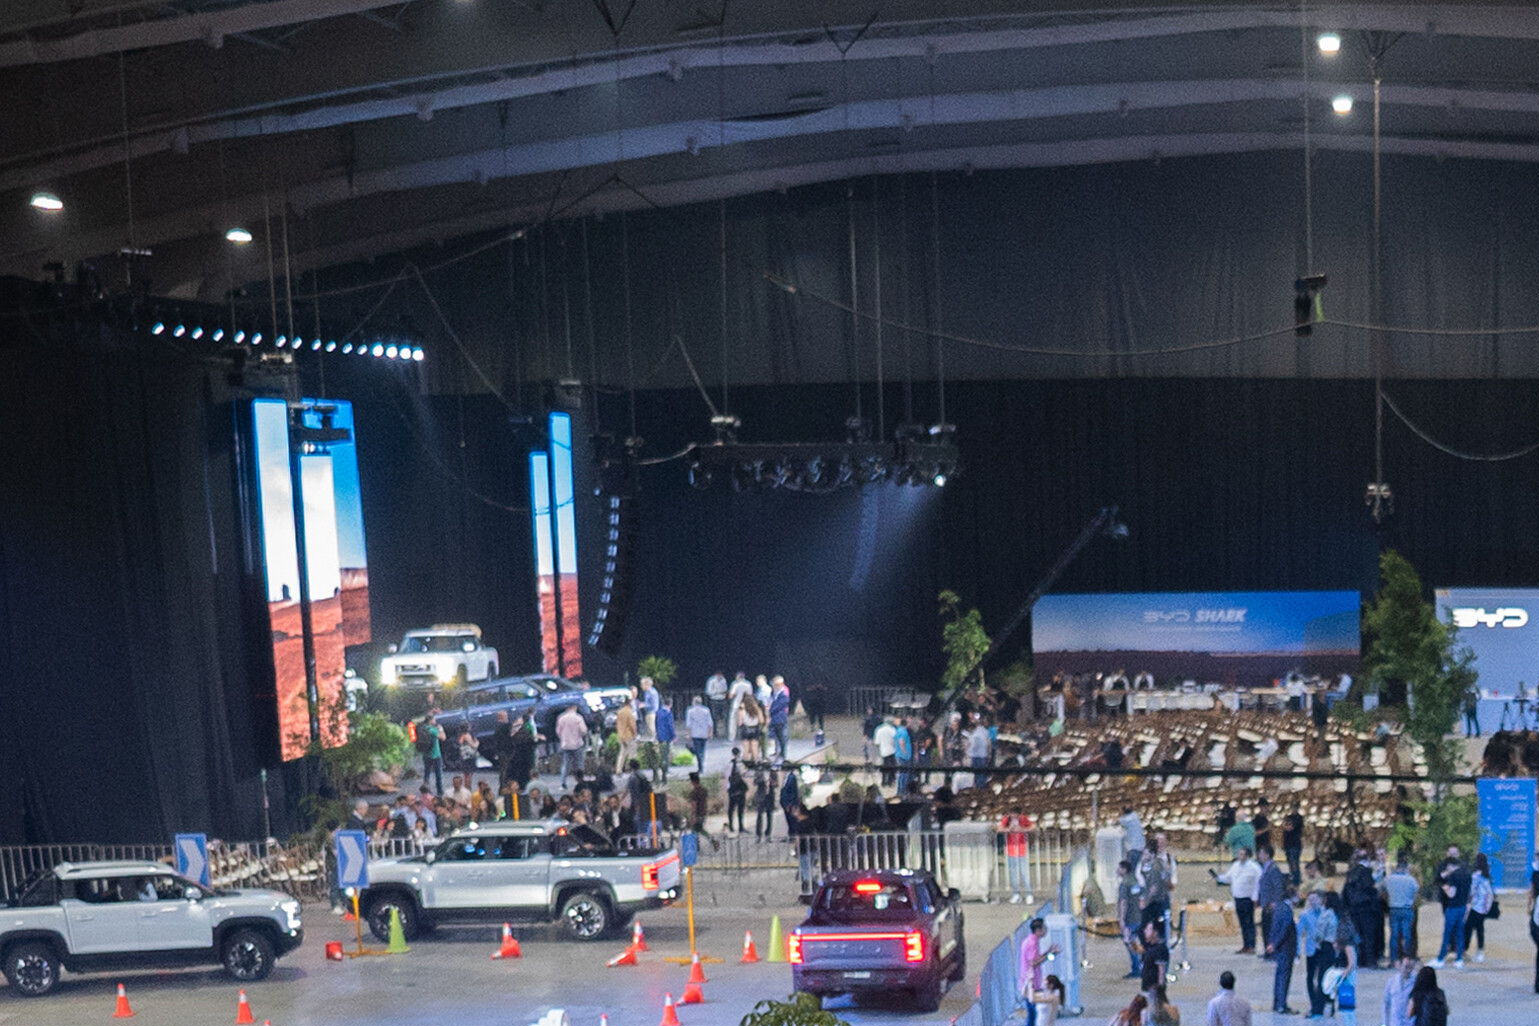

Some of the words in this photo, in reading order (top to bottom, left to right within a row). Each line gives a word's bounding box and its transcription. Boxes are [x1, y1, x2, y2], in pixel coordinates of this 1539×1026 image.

[1143, 610, 1191, 622] BYD
[1195, 609, 1247, 622] SHARK
[1453, 608, 1529, 628] BYD
